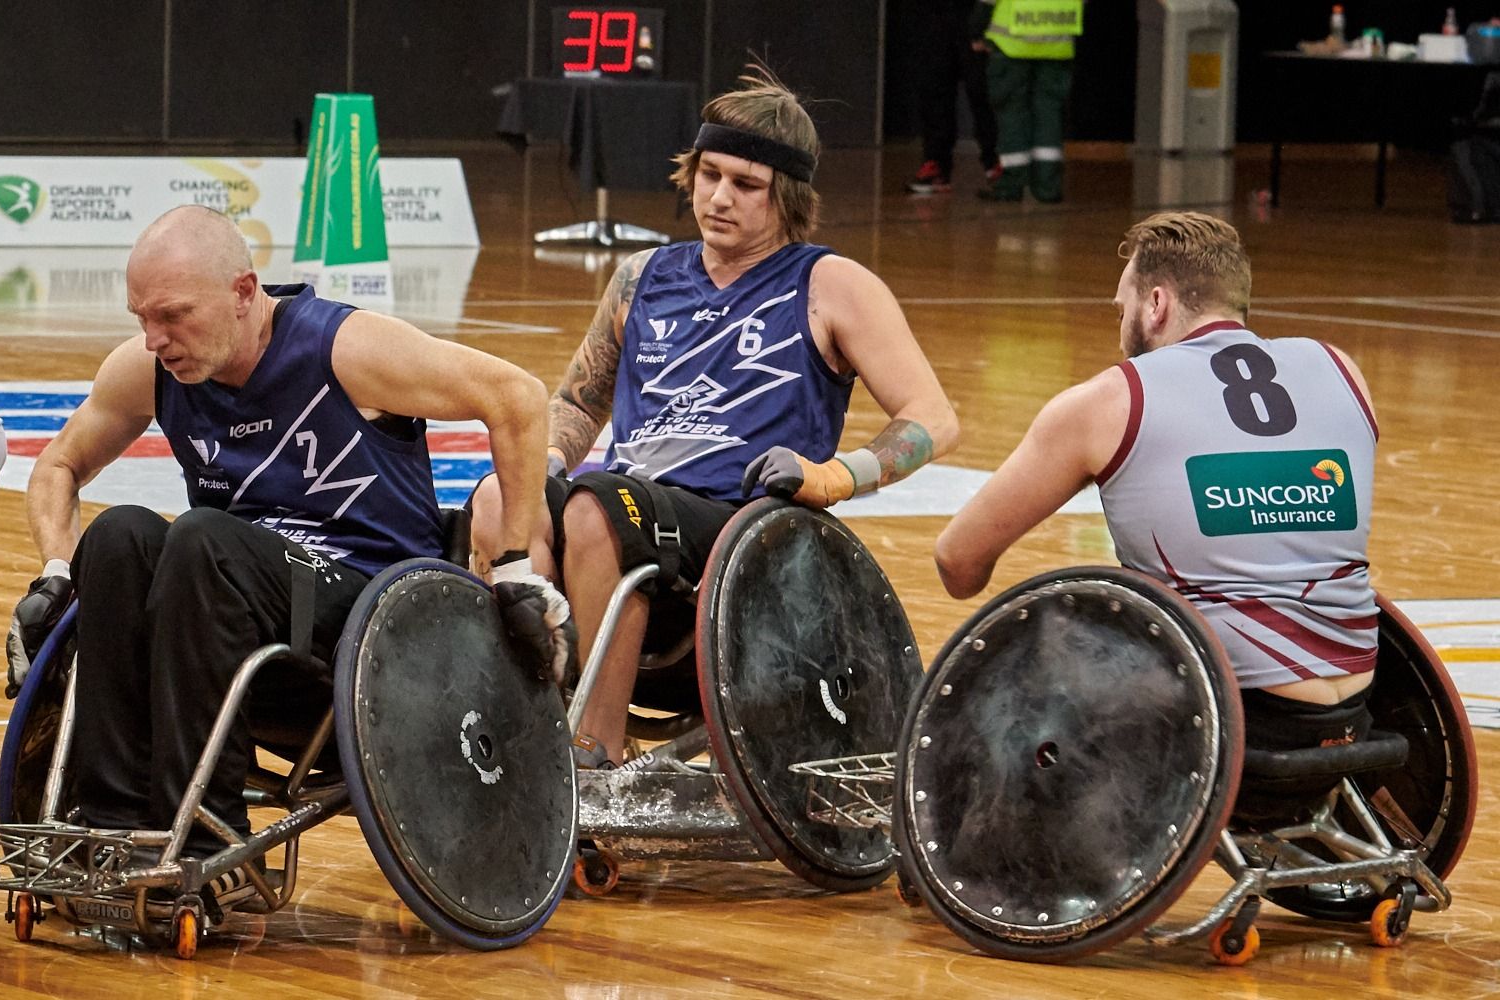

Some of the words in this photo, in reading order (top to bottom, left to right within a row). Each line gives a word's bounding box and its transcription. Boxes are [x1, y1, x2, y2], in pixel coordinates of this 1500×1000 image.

[563, 11, 638, 73] 39
[50, 185, 132, 197] DISABILITY
[169, 180, 250, 192] CHANGING
[51, 199, 116, 209] SPORTS
[50, 210, 132, 221] AUSTRALIA
[736, 317, 766, 357] 6
[1210, 342, 1298, 437] 8
[628, 422, 730, 442] THUNDER
[296, 430, 319, 479] 7
[198, 477, 230, 490] Protect
[1204, 485, 1336, 509] SUNCORP
[1250, 509, 1337, 526] Insurance
[77, 900, 133, 920] RHINO
